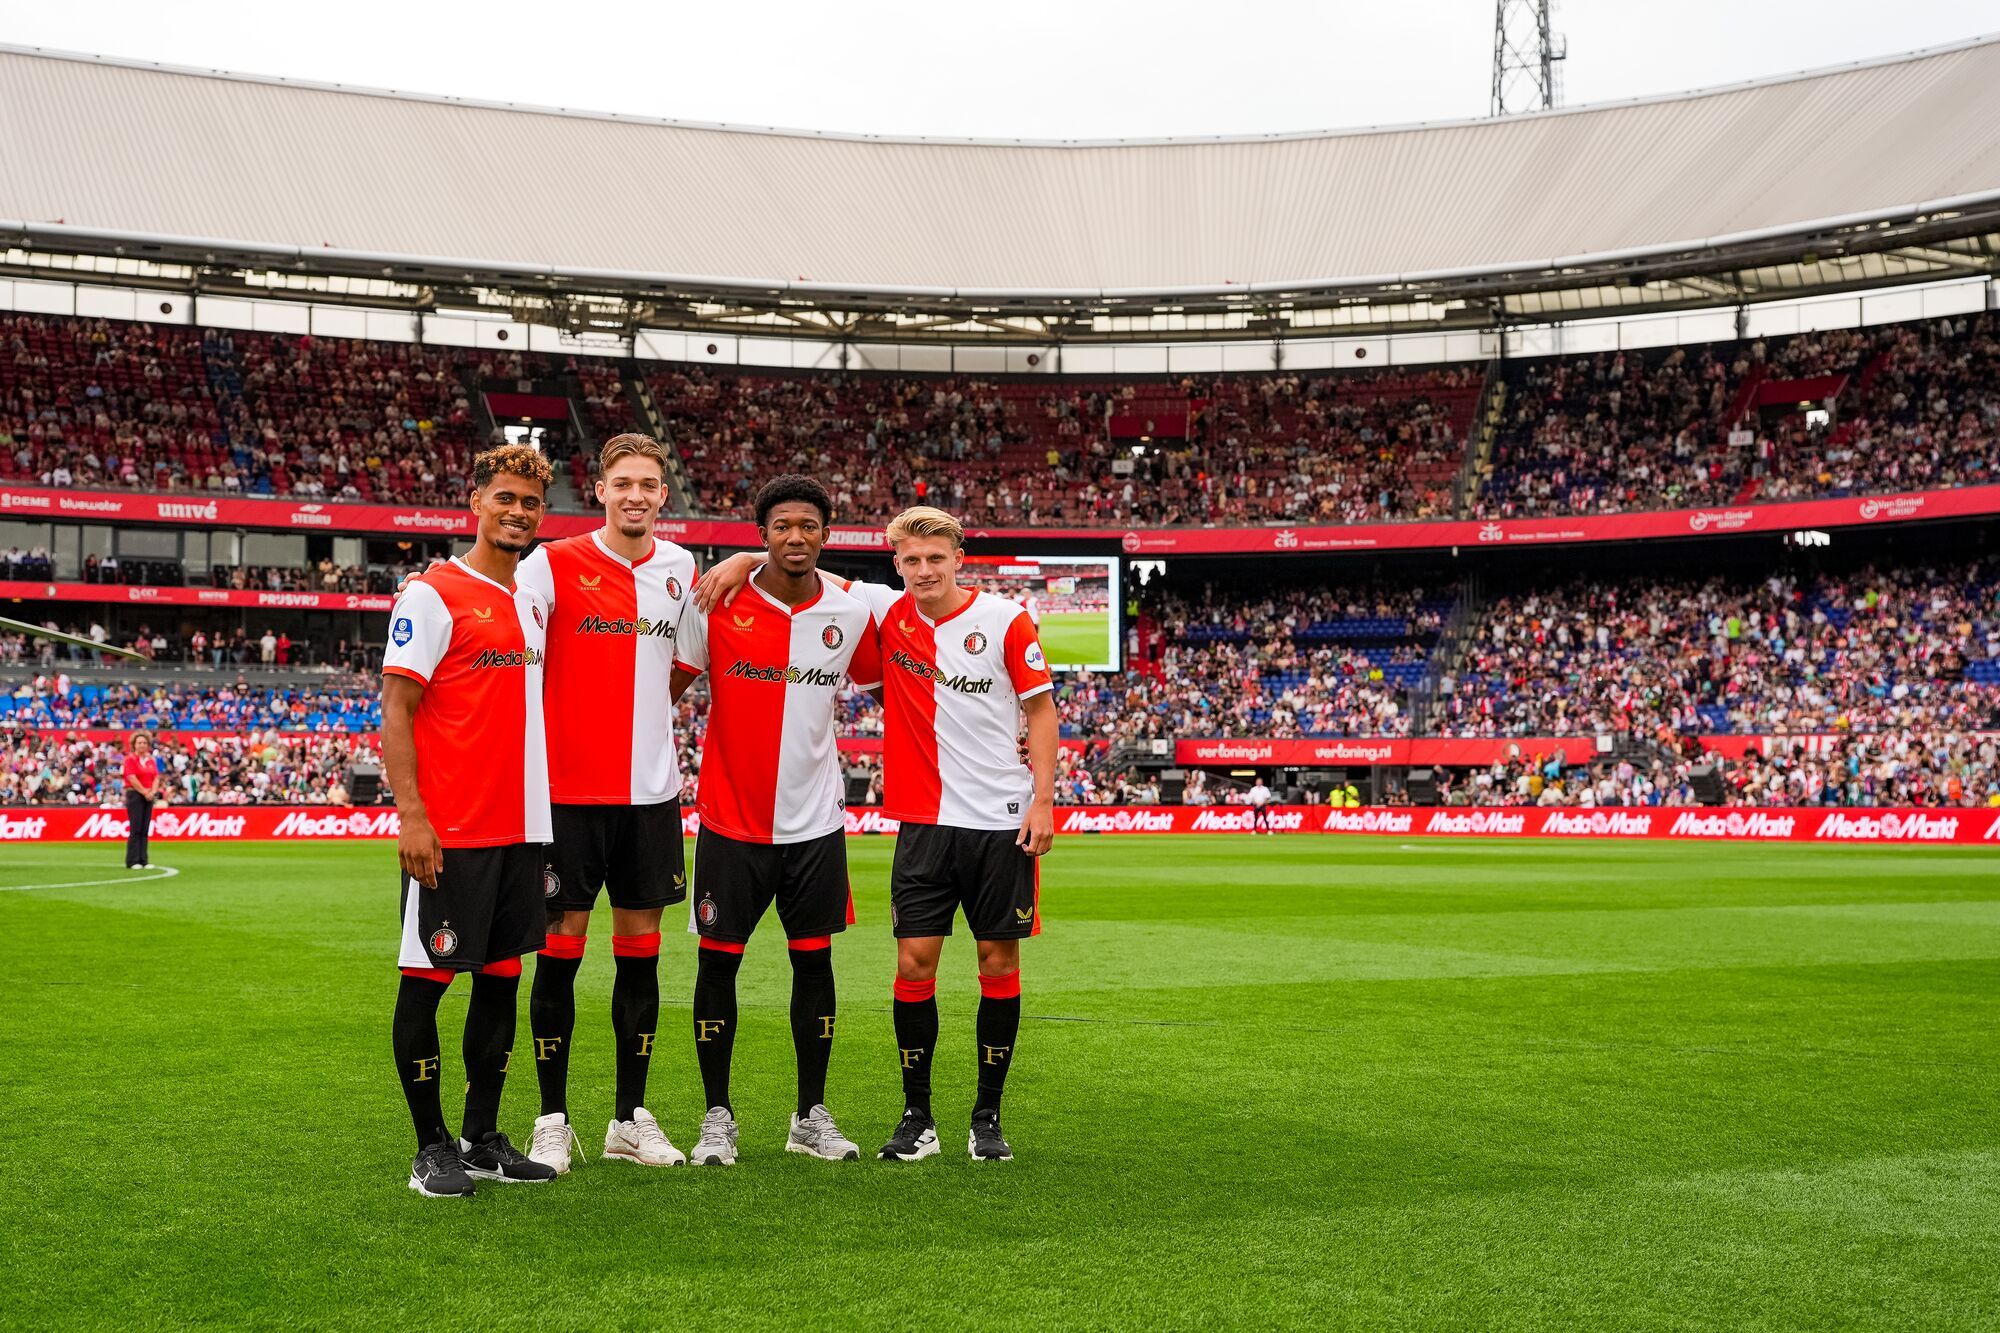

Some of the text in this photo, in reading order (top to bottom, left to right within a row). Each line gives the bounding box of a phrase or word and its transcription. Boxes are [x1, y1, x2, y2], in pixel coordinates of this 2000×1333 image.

[12, 496, 50, 508] DEME
[158, 501, 218, 520] univé
[577, 615, 633, 634] Media
[470, 649, 523, 670] Media
[726, 660, 841, 687] Media Markt
[889, 650, 994, 694] Media Markt
[1196, 743, 1272, 761] verloning.nl
[1315, 743, 1392, 761] verloning.nl
[176, 812, 246, 837] Markt
[272, 812, 349, 836] Media
[1061, 811, 1174, 831] Media Markt
[1191, 811, 1242, 830] Media
[1323, 810, 1412, 832] Media Markt
[1426, 811, 1525, 833] Media Markt
[1541, 811, 1652, 835] Media Markt
[1669, 811, 1796, 837] Media Markt
[1815, 813, 1880, 838] Media
[1898, 813, 1959, 839] Markt
[697, 1019, 726, 1042] F
[535, 1037, 561, 1061] F
[900, 1048, 925, 1069] F
[983, 1044, 1010, 1066] F
[412, 1055, 439, 1082] F
